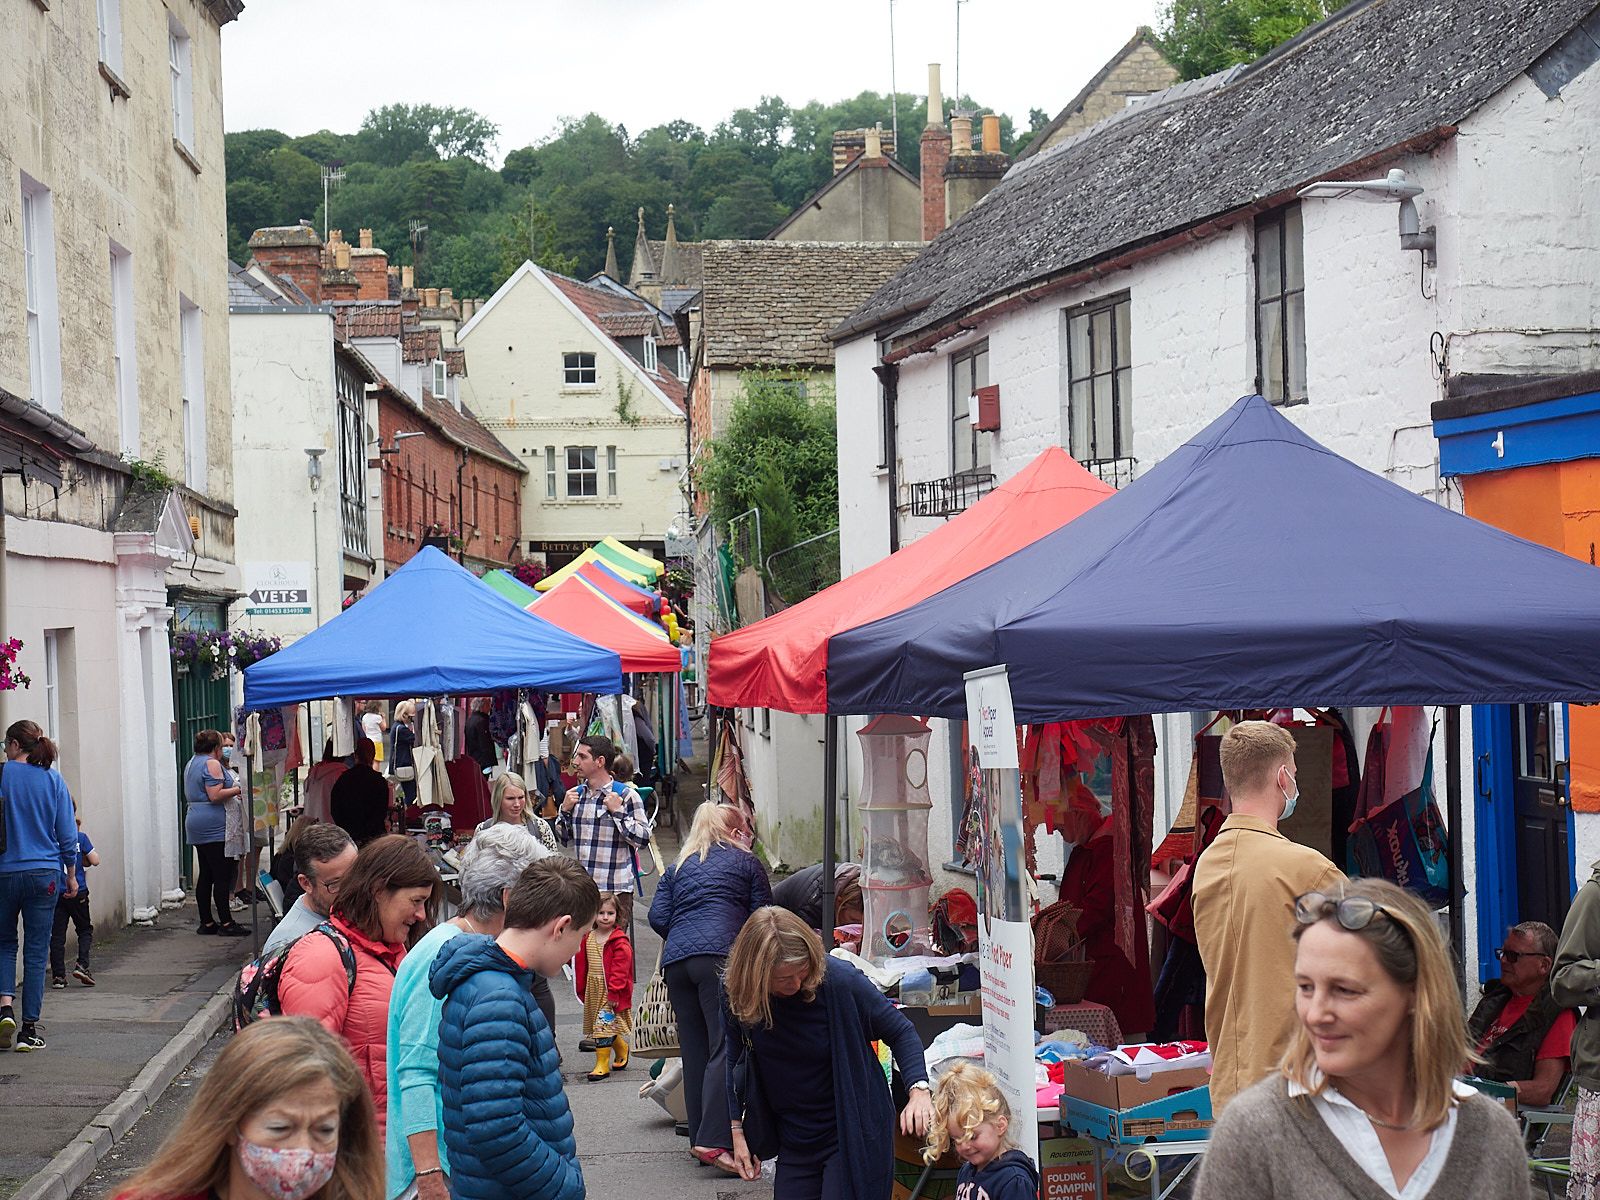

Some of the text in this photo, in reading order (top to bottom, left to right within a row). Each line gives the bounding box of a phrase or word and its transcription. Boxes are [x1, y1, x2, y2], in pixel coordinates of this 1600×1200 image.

[541, 542, 570, 551] BETTY
[572, 543, 580, 551] &
[258, 590, 299, 603] VETS
[1047, 1172, 1087, 1183] FOLDING
